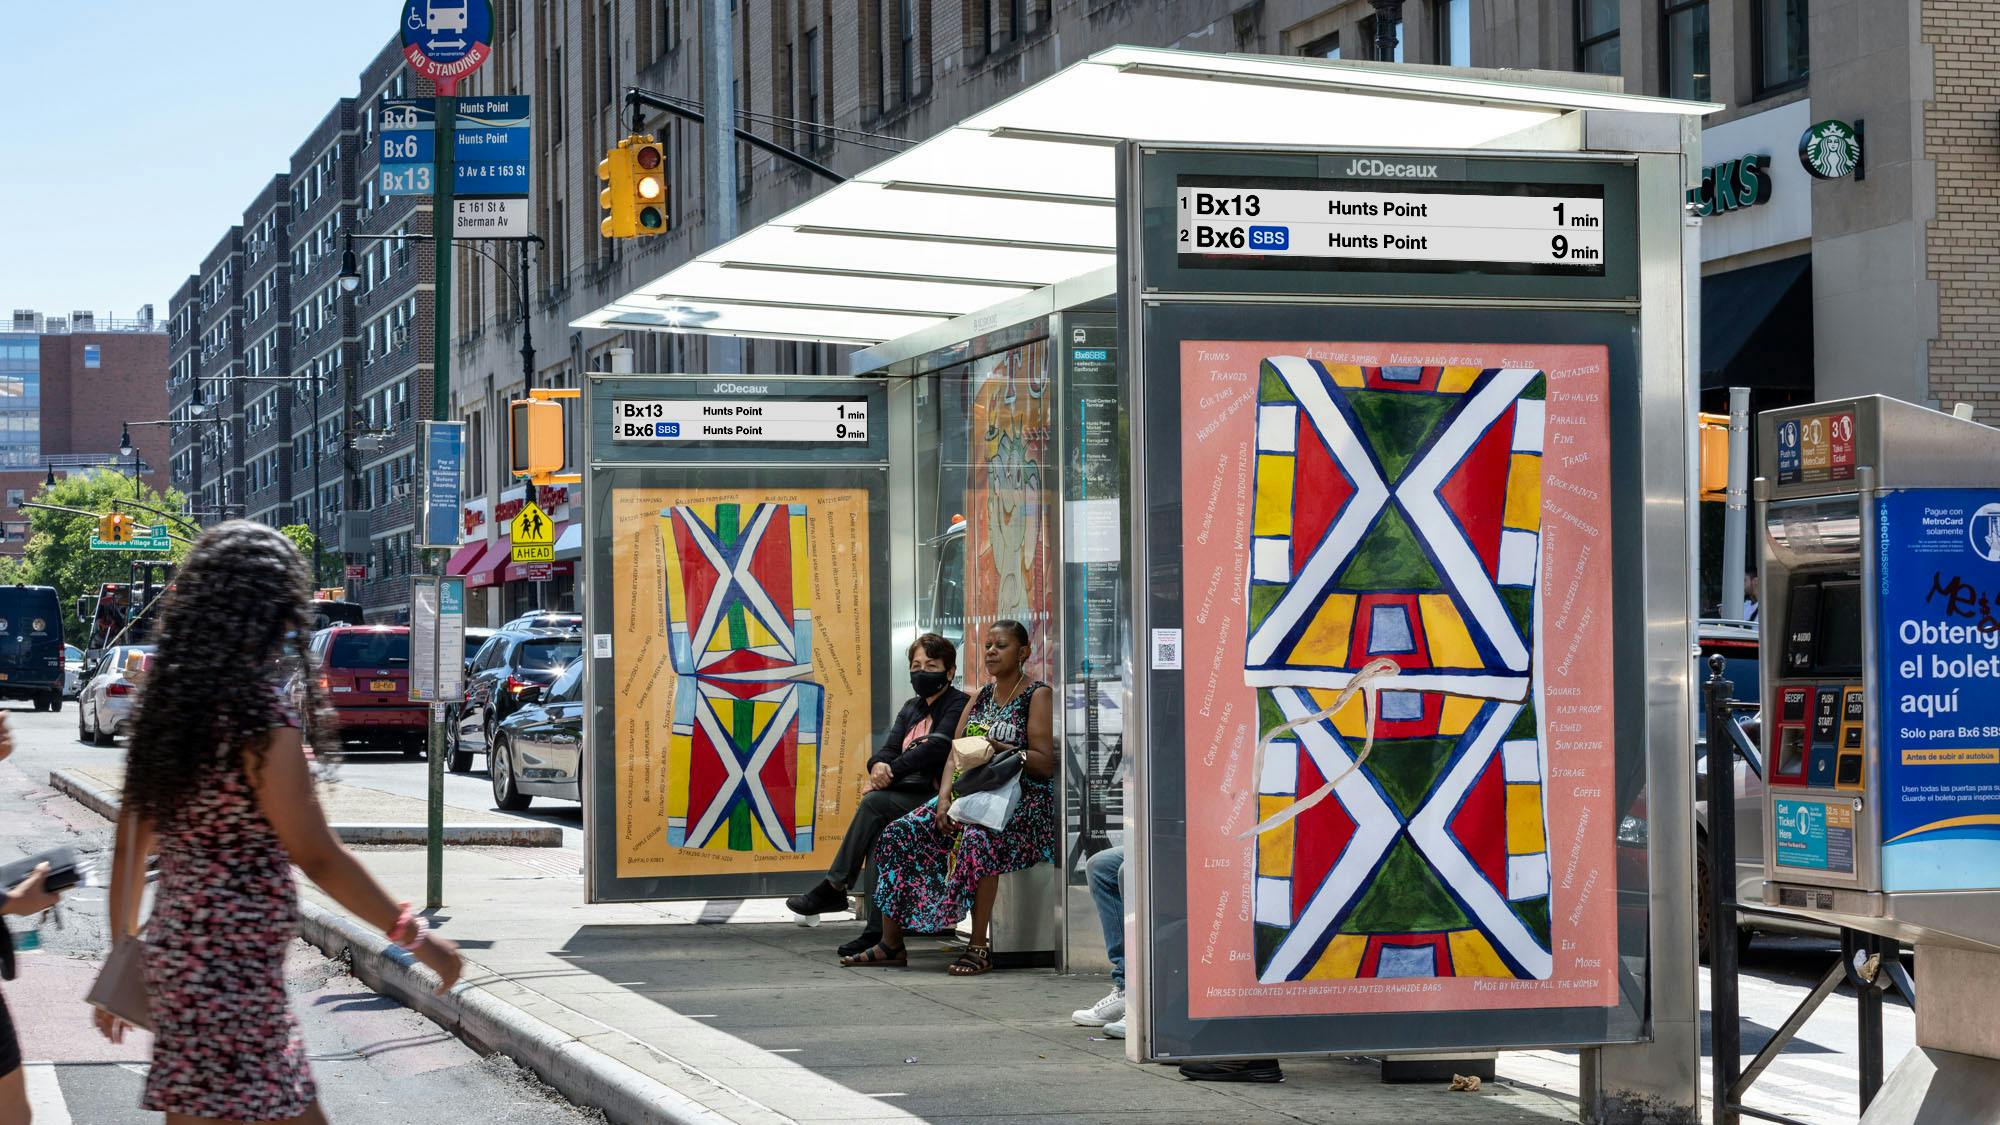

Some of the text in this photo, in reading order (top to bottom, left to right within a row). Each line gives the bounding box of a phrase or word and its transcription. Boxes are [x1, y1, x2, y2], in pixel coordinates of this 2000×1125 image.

[410, 49, 482, 76] NO STANDING
[460, 102, 509, 113] Hunts Point
[384, 106, 418, 129] Bx6
[458, 133, 508, 145] Hunts Point
[384, 135, 418, 158] Bx6
[459, 165, 526, 177] 3 Av & E 163 St
[1346, 160, 1438, 179] JCDecaux
[383, 167, 430, 190] Bx13
[1687, 153, 1764, 217] CKS
[459, 202, 506, 213] E 161 St &
[1180, 193, 1599, 228] 1 Bx13 Hunts Point 1 min
[458, 216, 508, 227] Sherman Av
[1180, 226, 1599, 260] 2 Bx6 SBS Hunts Point 9 min
[1197, 350, 1230, 361] TRUNKS
[1305, 347, 1313, 358] A
[1316, 352, 1350, 362] CULTURE
[1390, 353, 1483, 367] NARROW BAND OF COLOR
[1501, 358, 1535, 369] SKILLED
[1210, 370, 1248, 382] TRAVOIS
[1550, 365, 1600, 380] CONTAINERS
[713, 383, 768, 394] JCDecaux
[1200, 387, 1234, 409] CULTURE
[1552, 391, 1599, 402] TWO HALVES
[615, 404, 865, 420] 1 Bx13 Hunts Point 1 min
[1550, 415, 1587, 425] PARALLEL
[615, 423, 865, 439] 2 Bx6 SBS Hunts Point 9 min
[1803, 425, 1809, 441] 2
[1832, 421, 1839, 438] 3
[1553, 433, 1574, 445] FINE
[1780, 428, 1785, 444] 1
[1561, 452, 1590, 468] TRADE
[1924, 507, 1948, 517] Pague
[1923, 517, 1963, 526] MetroCard
[130, 539, 150, 547] Village
[153, 539, 168, 547] East
[517, 548, 550, 558] AHEAD
[1899, 619, 1999, 650] Obteng
[1900, 654, 2000, 679] el bolet
[1546, 686, 1581, 696] SQUARES
[1784, 693, 1804, 703] RECEIPT
[1821, 694, 1834, 703] PUSH
[1900, 687, 1960, 718] aquí
[1557, 705, 1578, 714] RAIN
[1824, 706, 1830, 715] TO
[1848, 704, 1862, 714] CARD
[1818, 717, 1833, 726] START
[1900, 727, 1926, 739] Solo
[1929, 728, 1955, 740] para
[1958, 726, 1980, 738] Bx6
[1555, 740, 1571, 750] SUN
[1906, 753, 1928, 761] Antes
[1928, 753, 1937, 761] de
[1966, 752, 1994, 760] autobús
[1552, 767, 1586, 777] STORAGE
[1951, 785, 1976, 793] puertas
[1977, 785, 1992, 793] para
[1902, 794, 1927, 802] Guarde
[1957, 795, 1972, 803] para
[1779, 816, 1795, 827] Ticket
[1562, 939, 1576, 950] ELK
[1229, 950, 1251, 962] BARS
[1575, 957, 1601, 968] MOOSE
[1207, 986, 1236, 998] HORSES
[1238, 987, 1283, 997] DECORATED
[1286, 987, 1307, 996] WITH
[1348, 985, 1384, 994] PAINTED
